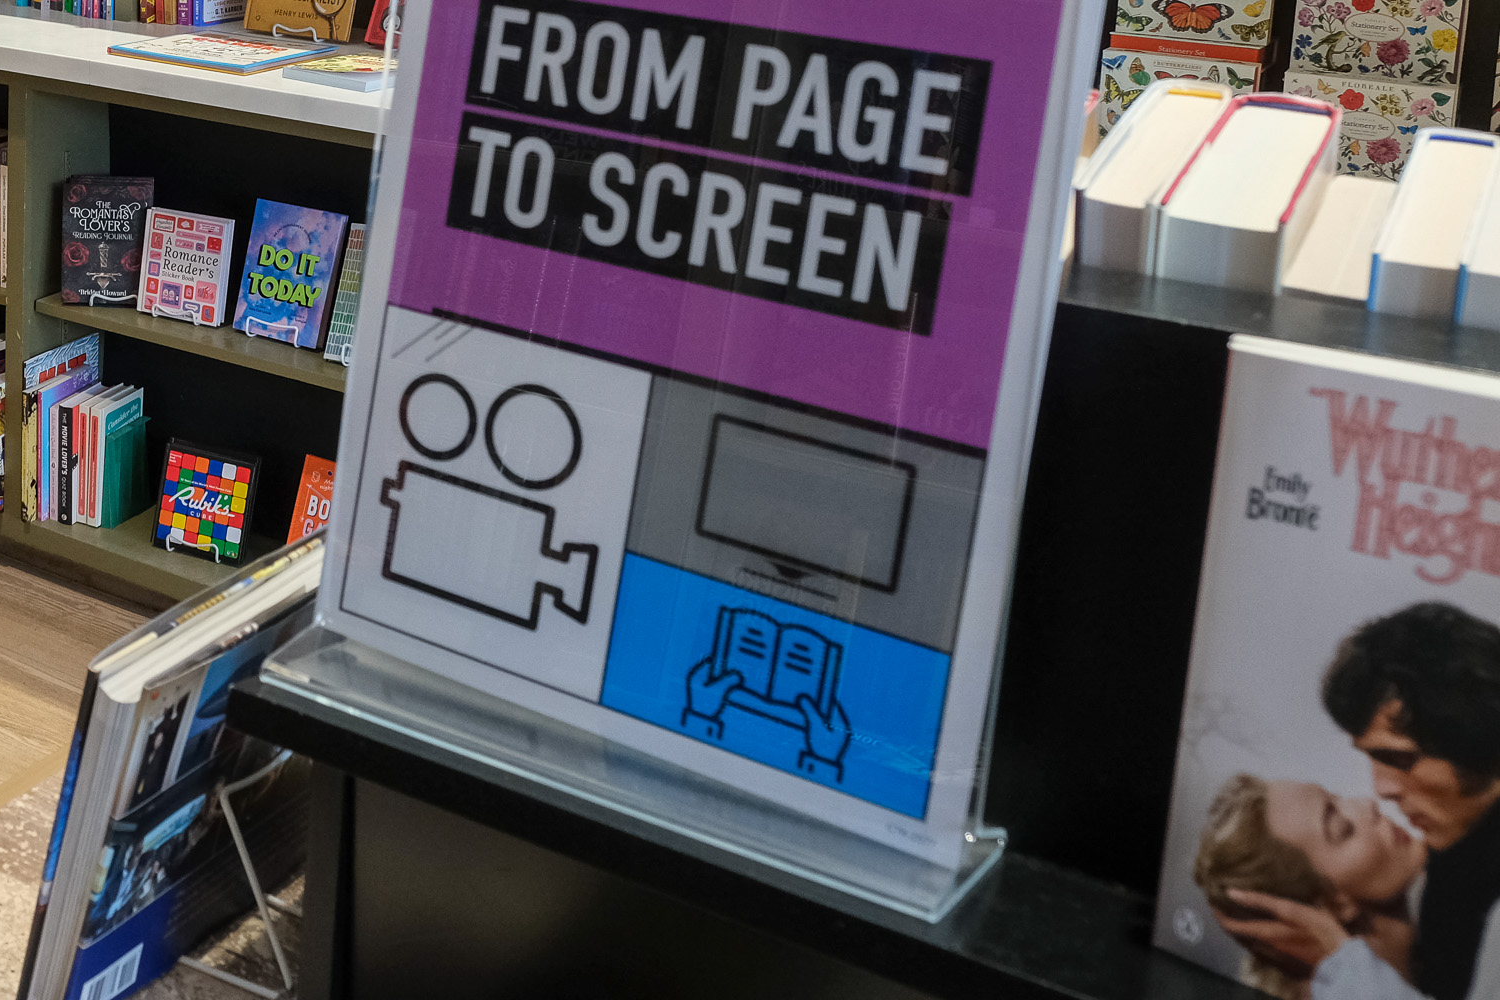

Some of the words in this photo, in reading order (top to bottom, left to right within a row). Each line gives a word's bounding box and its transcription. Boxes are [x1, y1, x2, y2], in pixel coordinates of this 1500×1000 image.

[275, 9, 296, 17] HENRY
[1350, 20, 1386, 32] Stationery
[1157, 45, 1192, 57] Stationery
[1195, 48, 1206, 57] Set
[479, 4, 706, 130] FROM
[730, 43, 963, 177] PAGE
[1341, 81, 1395, 92] FLOREALE
[70, 202, 140, 221] ROMANTASY
[468, 126, 556, 229] TO
[580, 151, 922, 313] SCREEN
[79, 218, 130, 232] LOVER'S
[166, 238, 173, 246] A
[164, 246, 219, 267] Romance
[259, 245, 294, 271] DO
[298, 249, 320, 276] IT
[163, 259, 214, 280] Reader's
[249, 272, 321, 308] TODAY
[1309, 387, 1500, 491] Wuthe
[1264, 463, 1312, 499] Emily
[190, 511, 213, 521] CUBE
[1245, 486, 1320, 531] Brontë
[1351, 483, 1500, 585] Heigh
